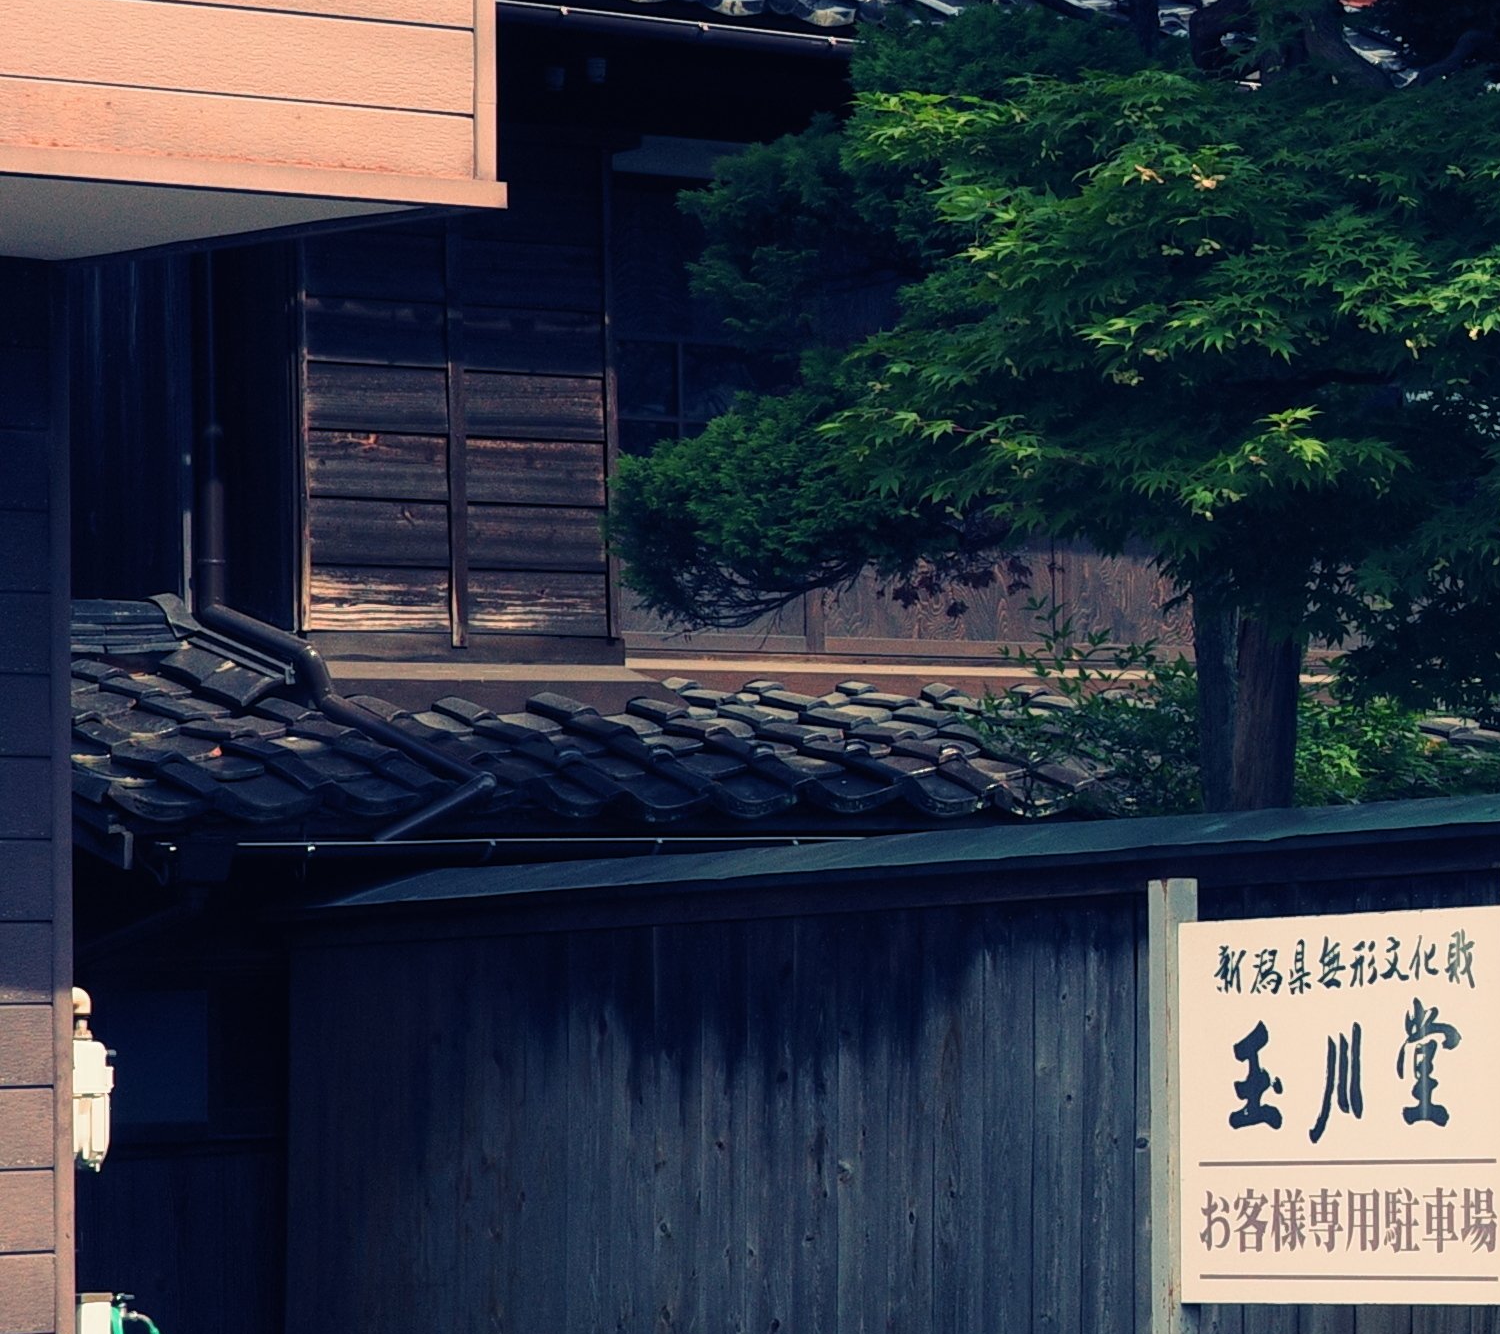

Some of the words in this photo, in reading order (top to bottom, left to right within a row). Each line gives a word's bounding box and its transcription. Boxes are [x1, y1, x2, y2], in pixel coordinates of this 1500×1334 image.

[1213, 928, 1477, 996] 新潟県無形文化財
[1227, 996, 1463, 1145] 玉川堂
[1199, 1186, 1498, 1255] お客様専用駐車場
